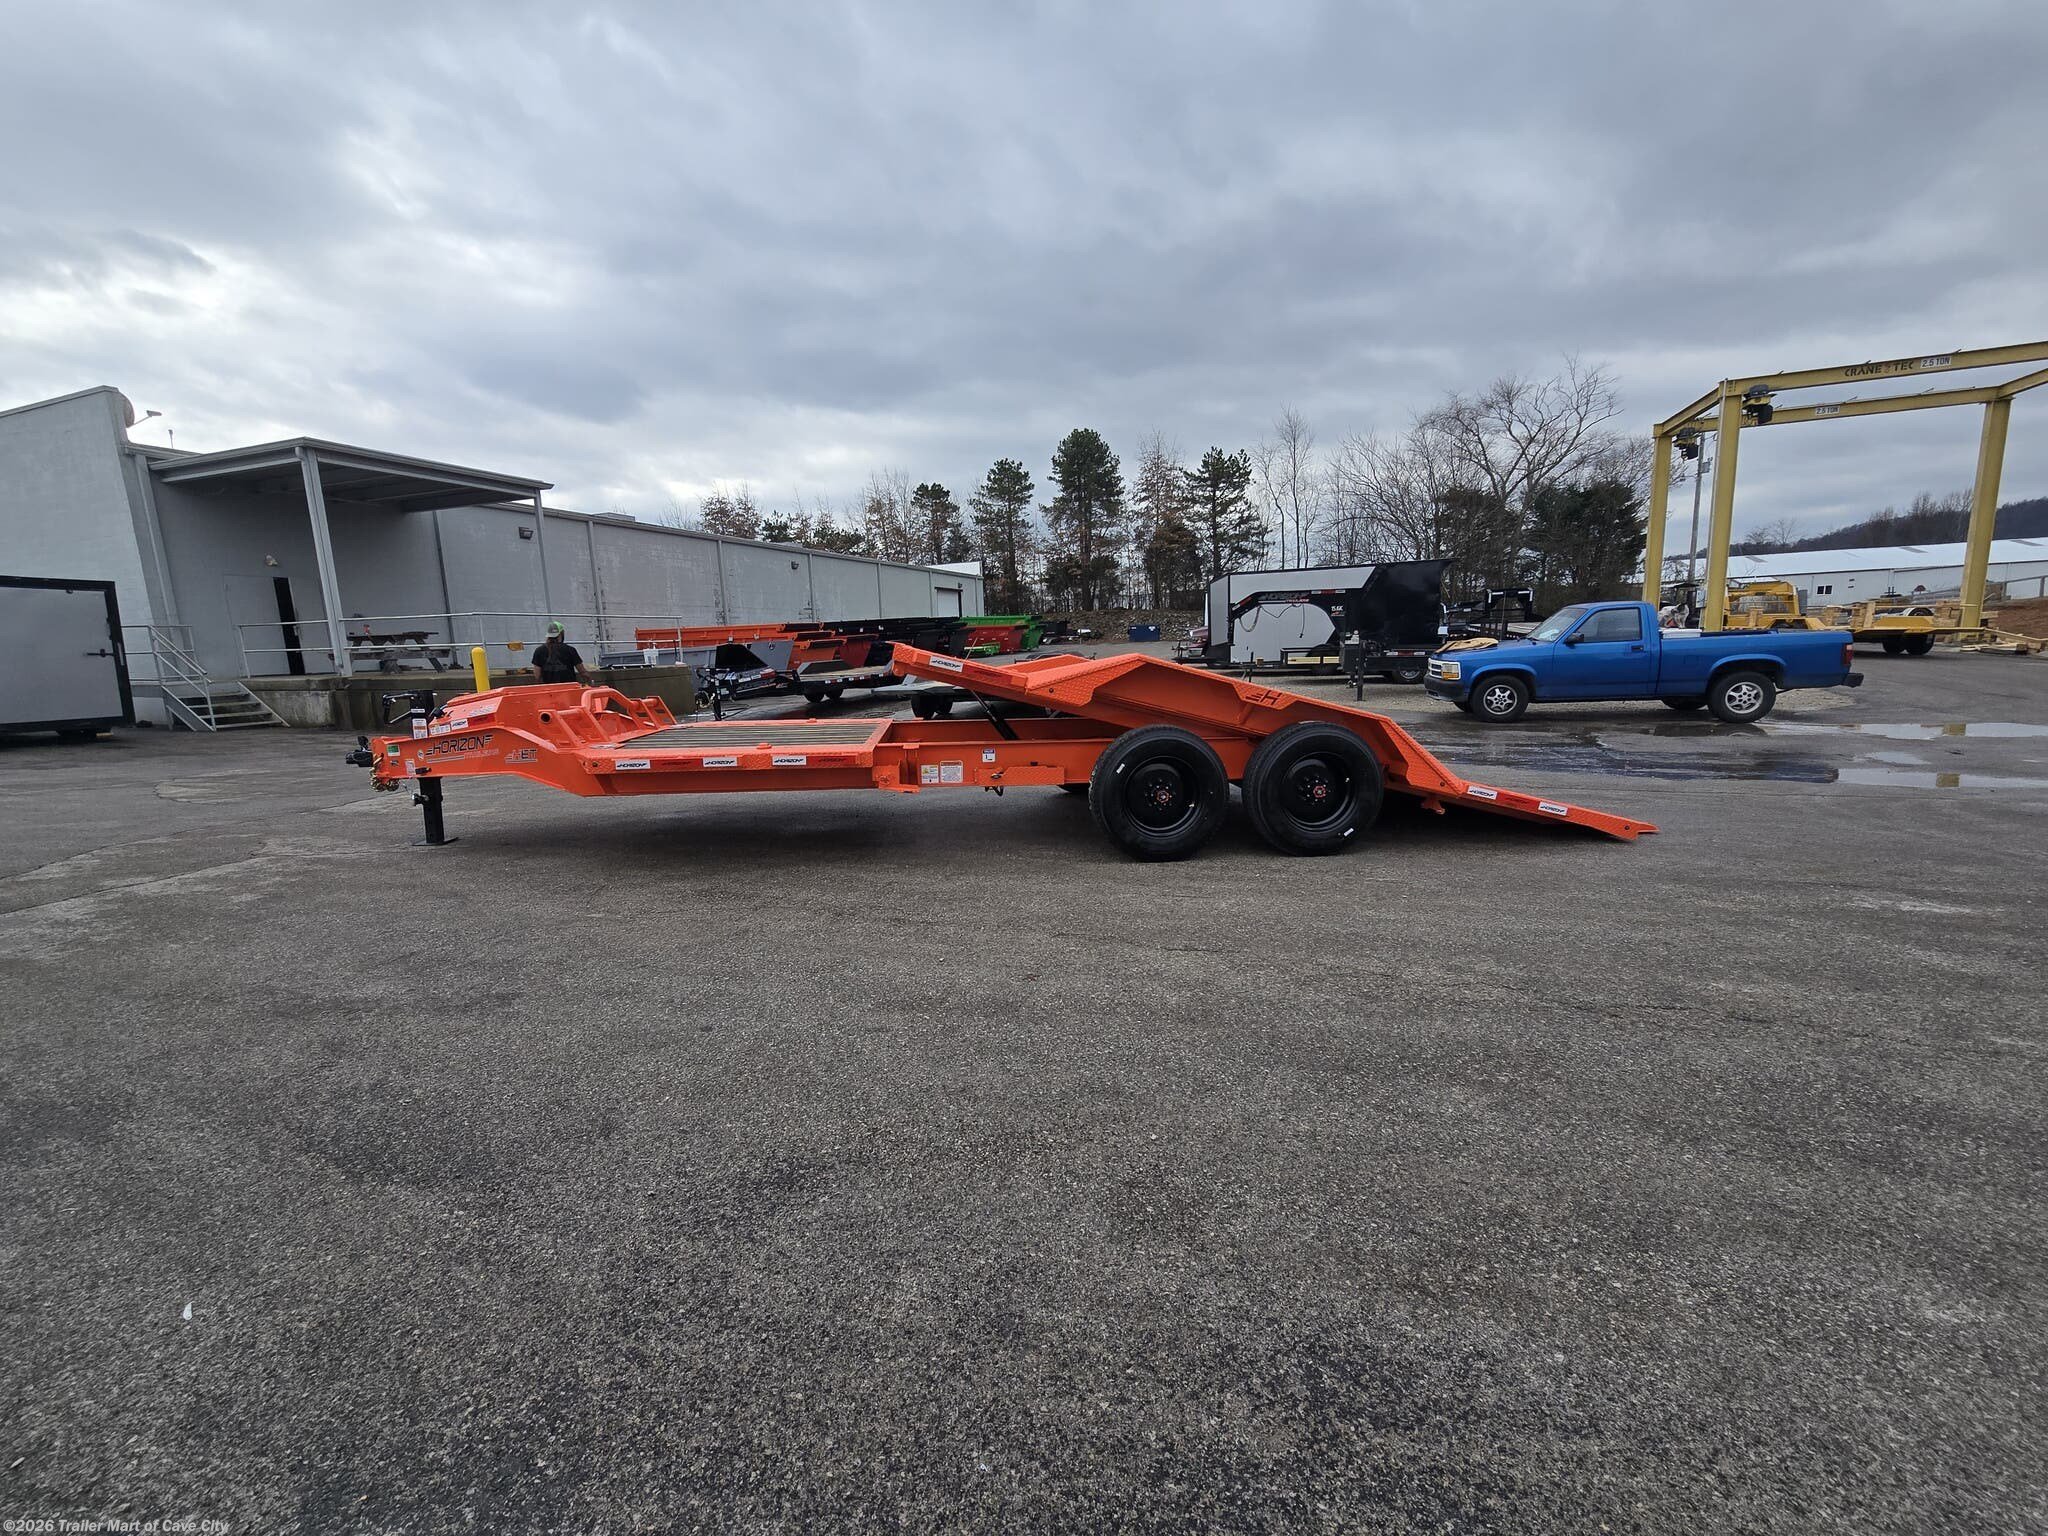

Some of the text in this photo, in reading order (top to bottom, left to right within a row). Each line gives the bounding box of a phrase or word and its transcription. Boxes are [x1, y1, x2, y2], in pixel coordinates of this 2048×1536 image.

[1922, 358, 1934, 367] 2.5
[1844, 364, 1882, 377] CRANE
[428, 736, 491, 754] HORIZON
